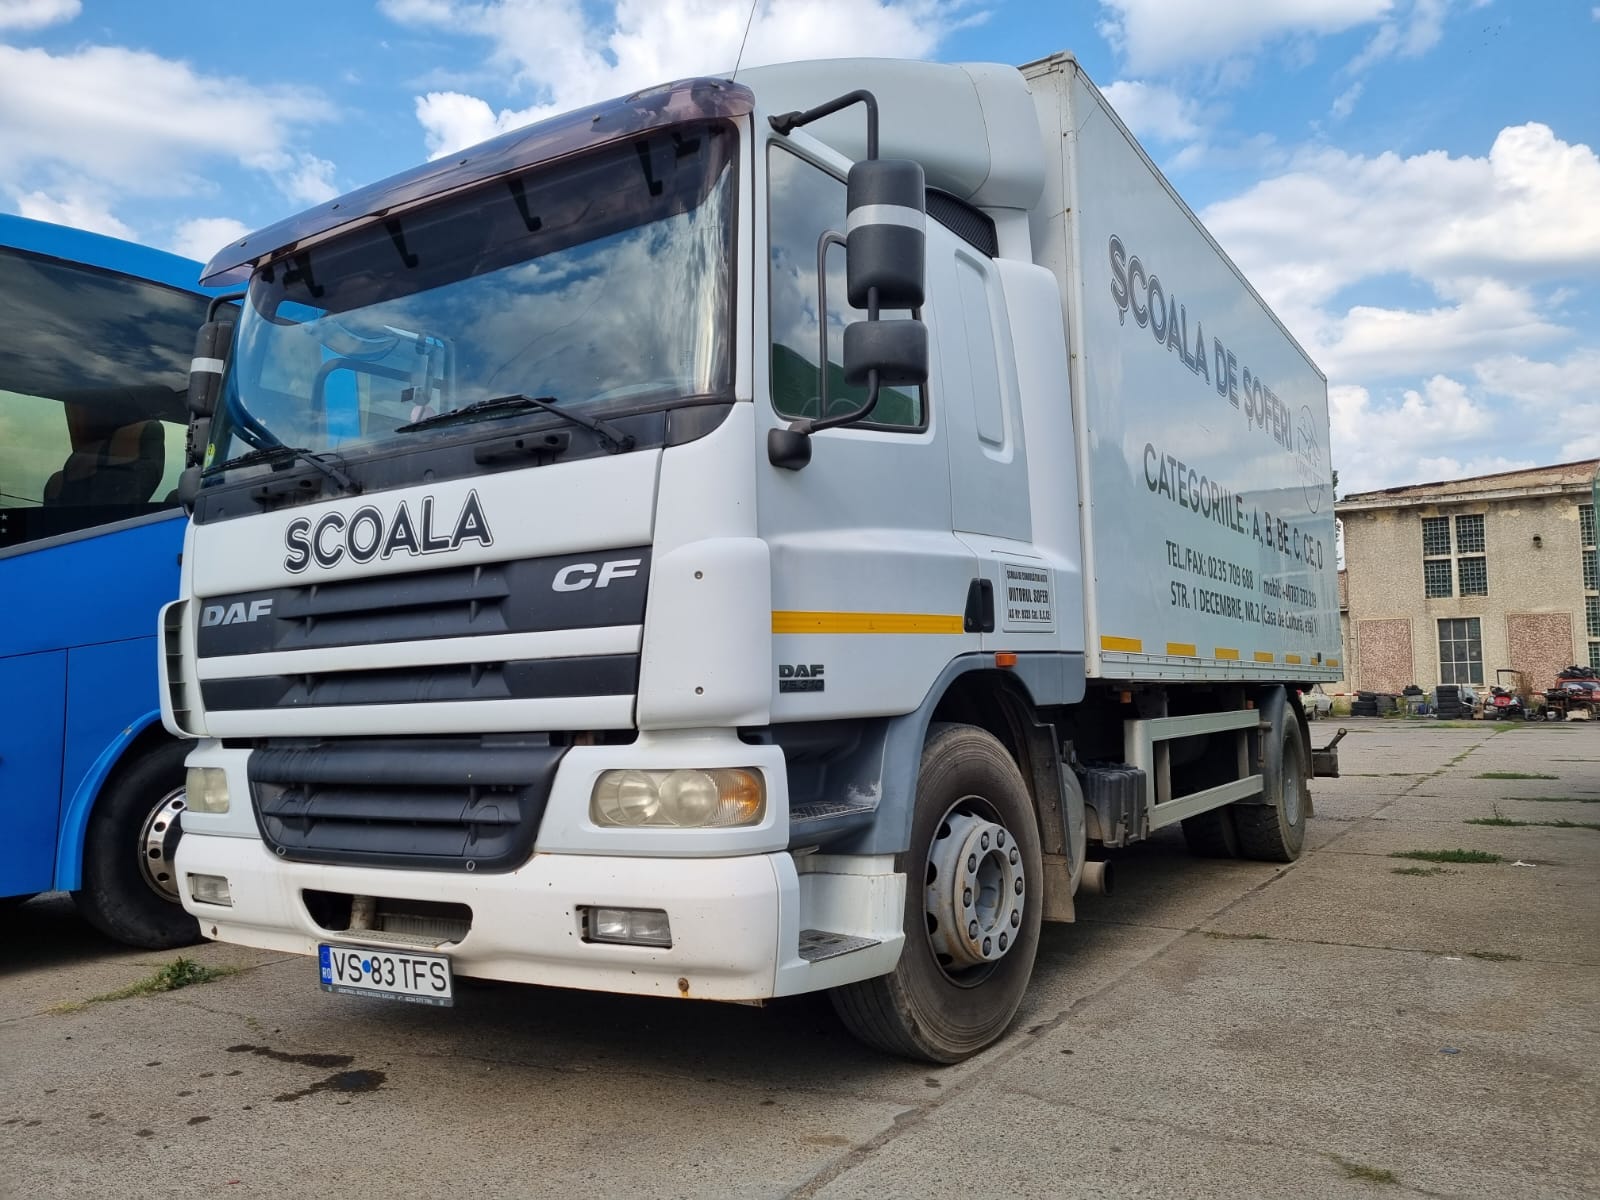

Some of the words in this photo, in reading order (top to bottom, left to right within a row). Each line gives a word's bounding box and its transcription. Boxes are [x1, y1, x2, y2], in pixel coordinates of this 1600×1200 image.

[1214, 336, 1239, 410] DE
[283, 488, 494, 573] SCOALA
[551, 558, 642, 592] CF
[1166, 539, 1207, 577] TEL./FAX:
[1208, 555, 1227, 583] 0235
[1228, 562, 1241, 587] 709
[1171, 580, 1190, 609] STR.
[1192, 587, 1197, 611] 1
[201, 598, 273, 627] DAF
[779, 664, 824, 678] DAF
[322, 967, 331, 979] RO
